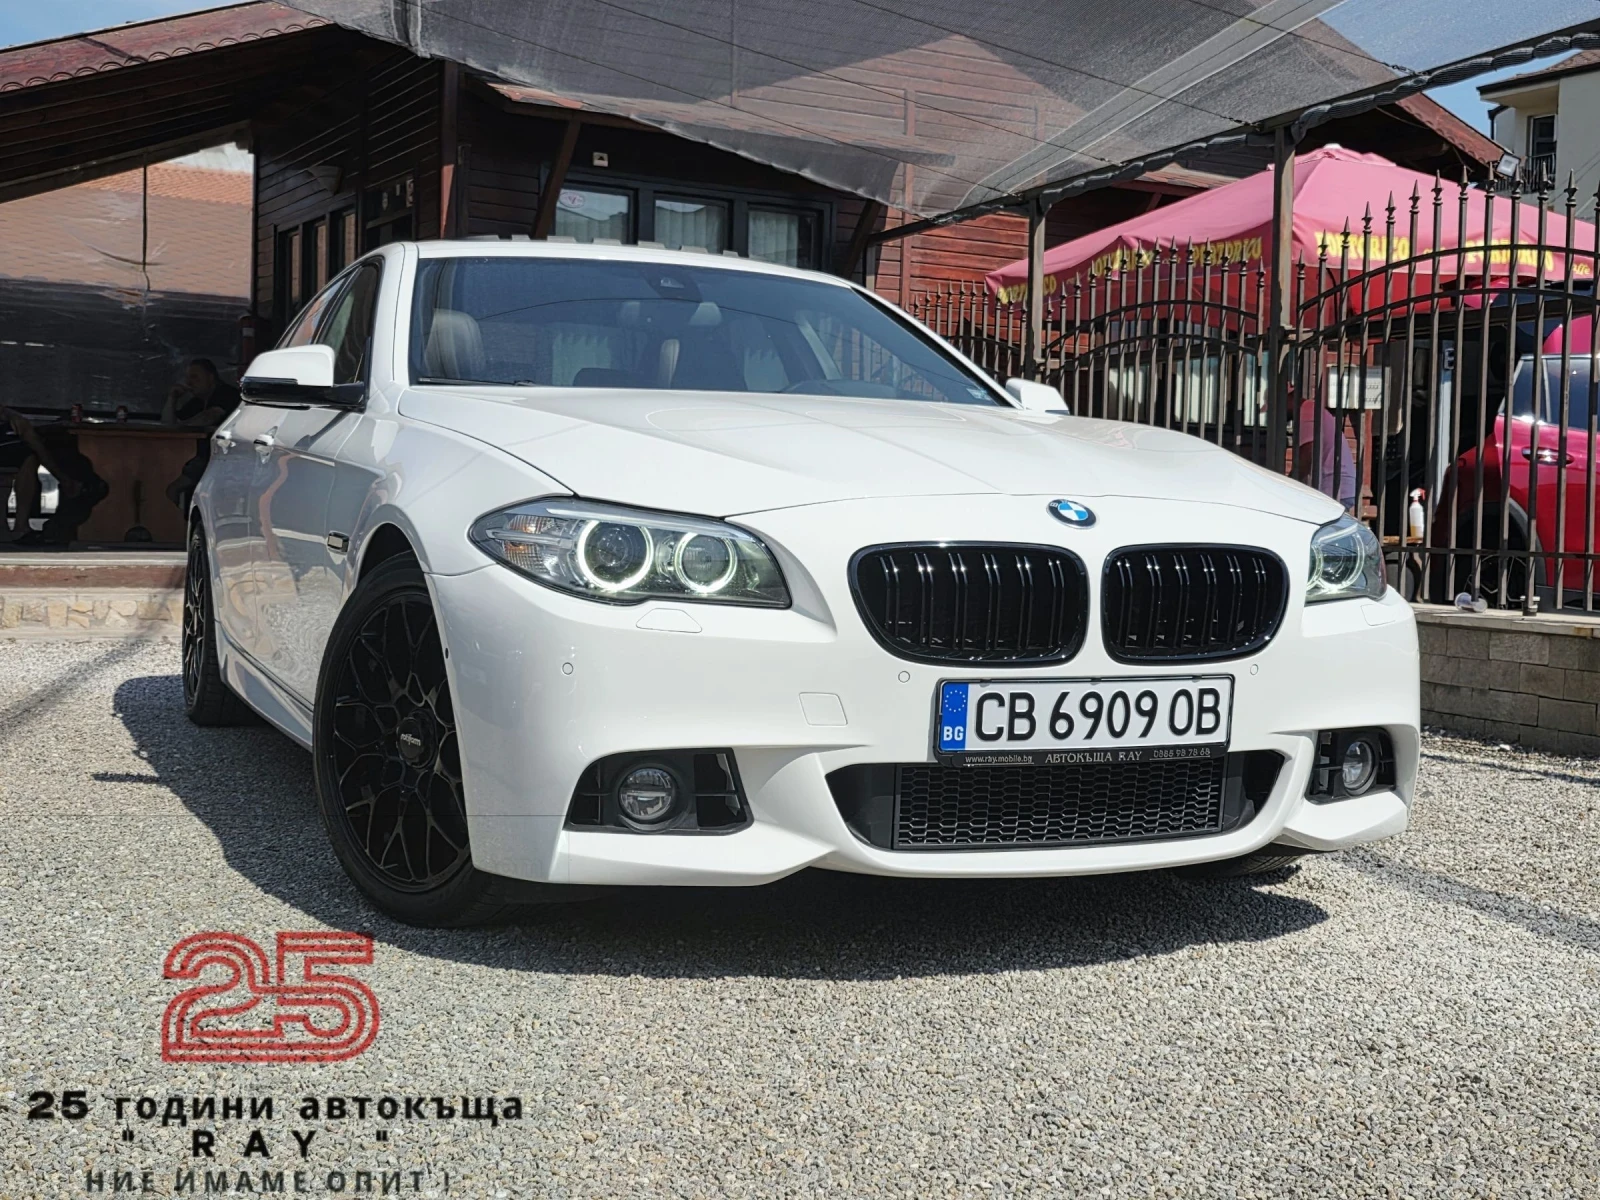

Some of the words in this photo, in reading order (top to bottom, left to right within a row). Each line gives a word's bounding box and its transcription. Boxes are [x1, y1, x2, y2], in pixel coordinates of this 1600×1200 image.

[974, 691, 1037, 742] CB
[1049, 689, 1159, 741] 6909
[943, 726, 964, 741] BG
[965, 754, 1033, 764] www.ray.mobile.bg
[1045, 751, 1113, 764] АВТОКЪЩА
[1118, 750, 1142, 761] RAY
